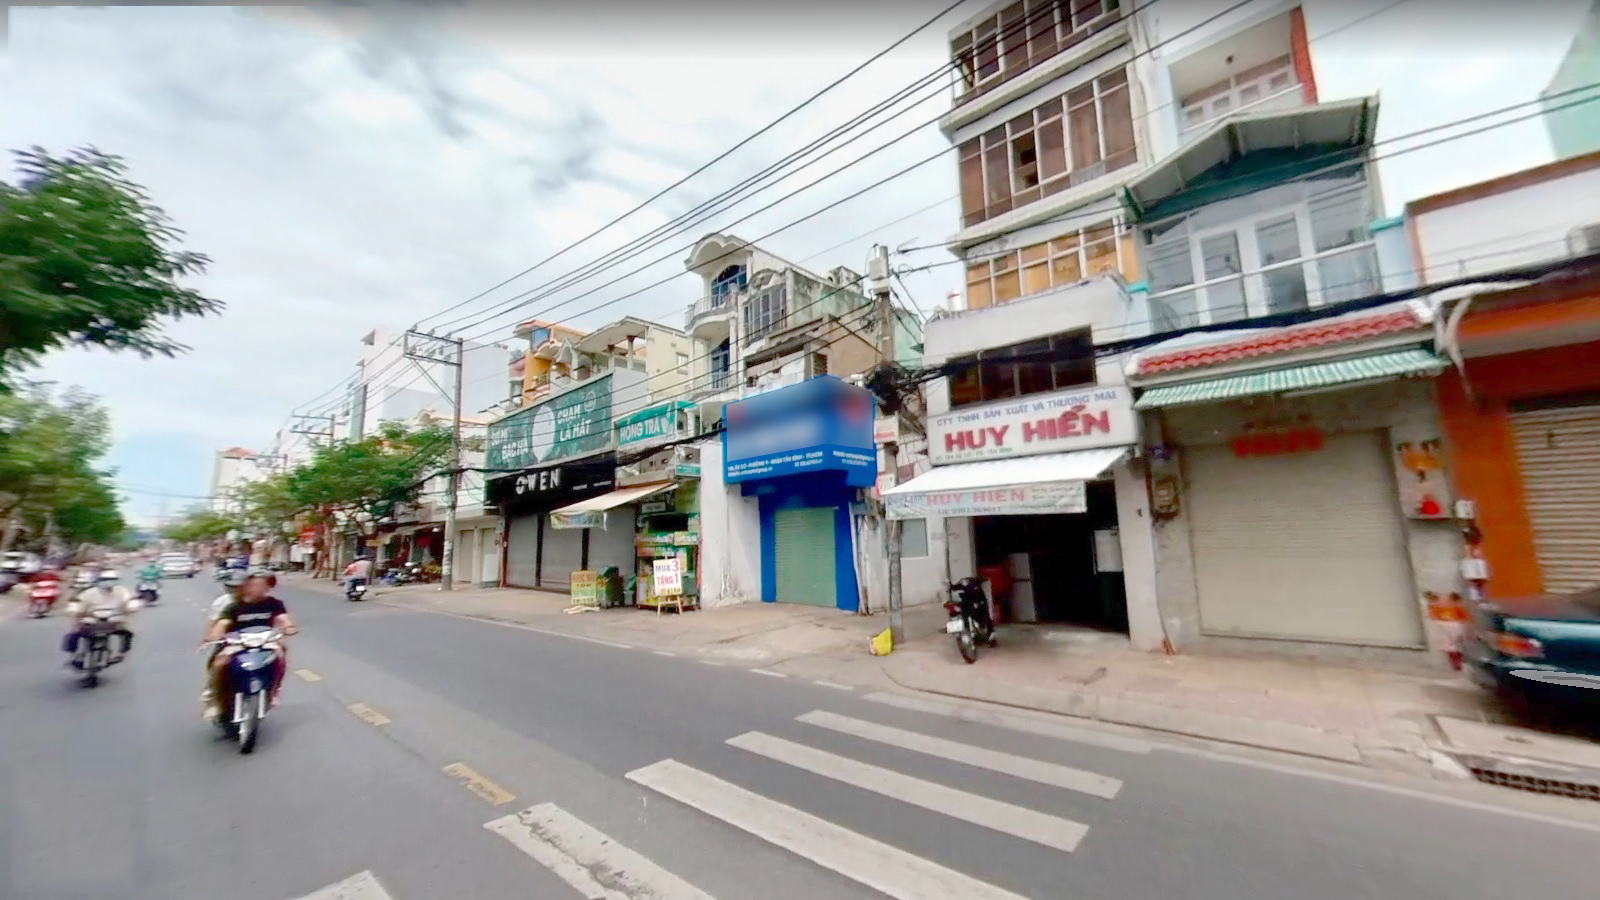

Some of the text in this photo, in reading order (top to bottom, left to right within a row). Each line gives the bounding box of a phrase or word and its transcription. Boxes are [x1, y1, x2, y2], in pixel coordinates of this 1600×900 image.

[944, 424, 1010, 453] HUY
[515, 468, 561, 495] OWEN
[671, 560, 679, 572] 3
